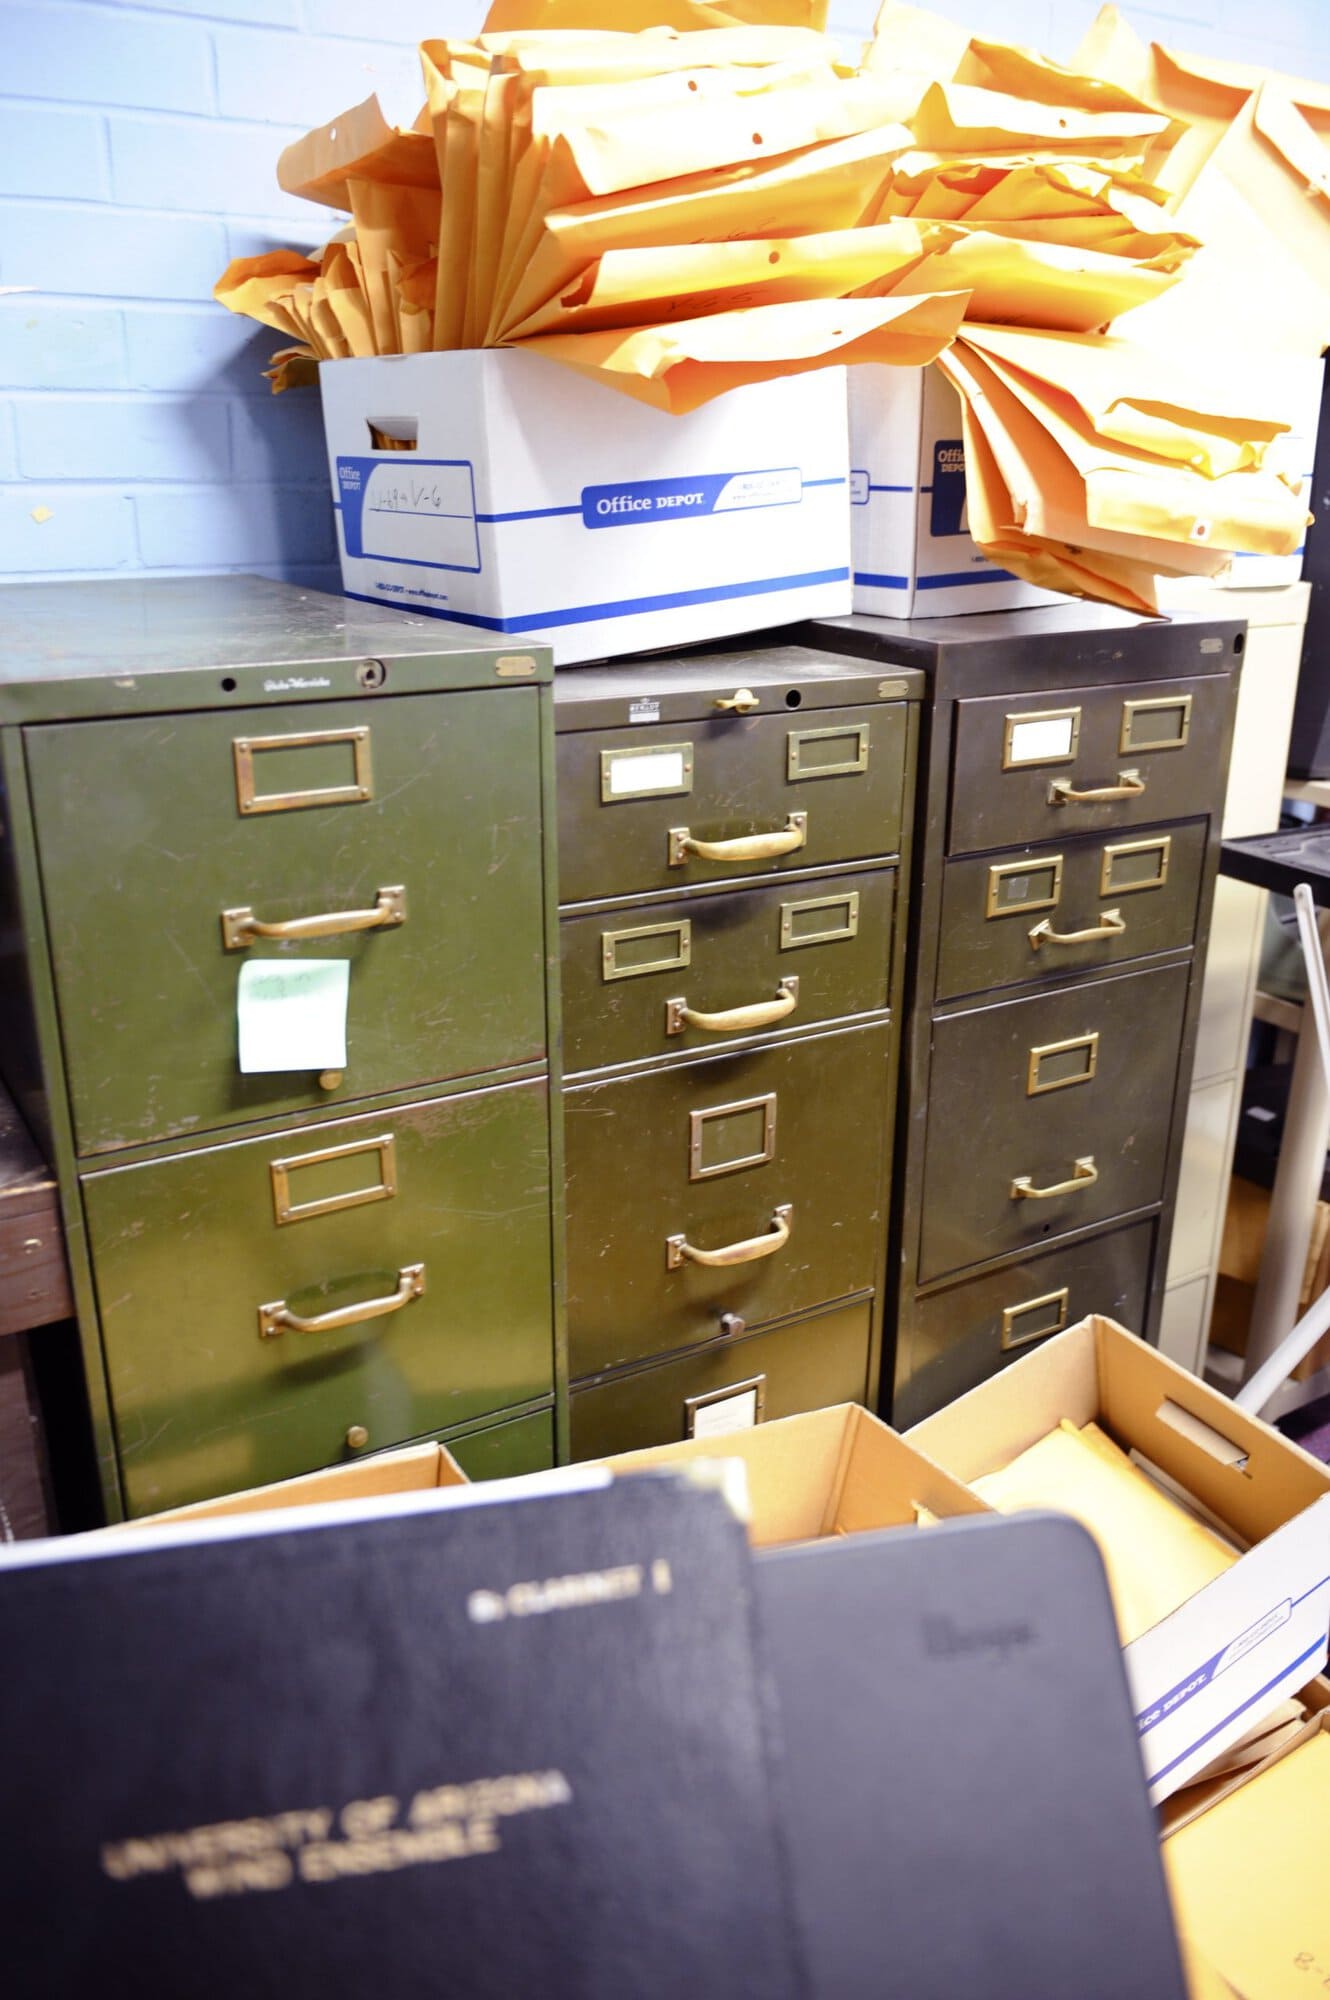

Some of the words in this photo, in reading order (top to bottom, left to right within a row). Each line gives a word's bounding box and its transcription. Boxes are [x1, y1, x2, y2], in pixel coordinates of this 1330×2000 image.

[938, 448, 965, 463] Offi
[339, 466, 361, 480] Office
[941, 463, 965, 473] DEPO
[596, 495, 653, 515] Office
[656, 493, 705, 509] DEPOT
[1138, 1709, 1162, 1729] ice
[1162, 1672, 1207, 1713] DEPOT
